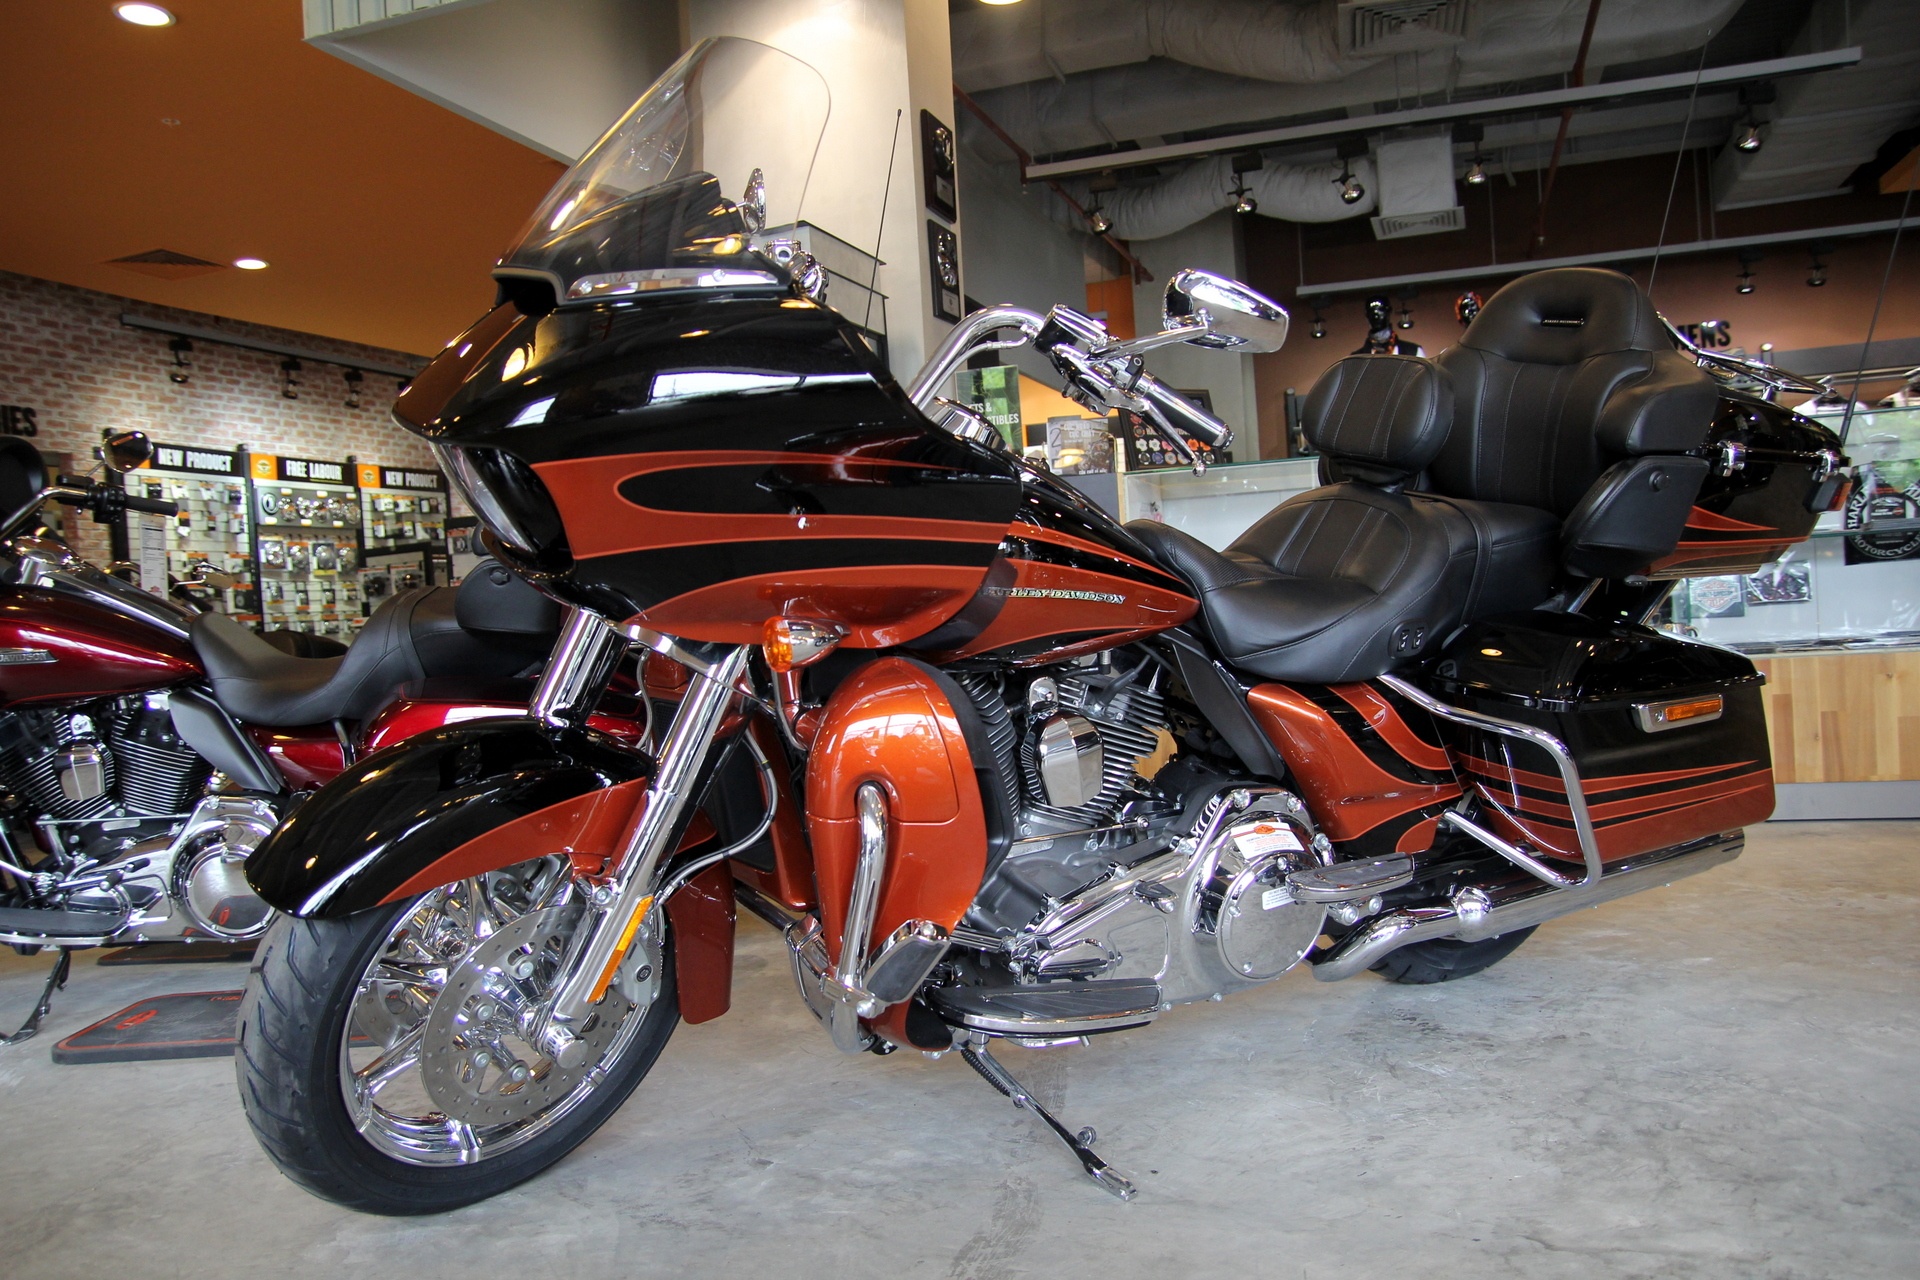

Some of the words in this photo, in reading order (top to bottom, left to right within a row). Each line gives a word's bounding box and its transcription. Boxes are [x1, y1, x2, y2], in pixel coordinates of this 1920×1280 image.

[985, 402, 992, 412] &
[157, 447, 184, 467] NEW
[185, 450, 233, 472] PRODUCT
[285, 459, 308, 478] FREE
[308, 462, 343, 481] LABOUR
[385, 470, 404, 487] NEW
[404, 472, 438, 489] PRODUCT
